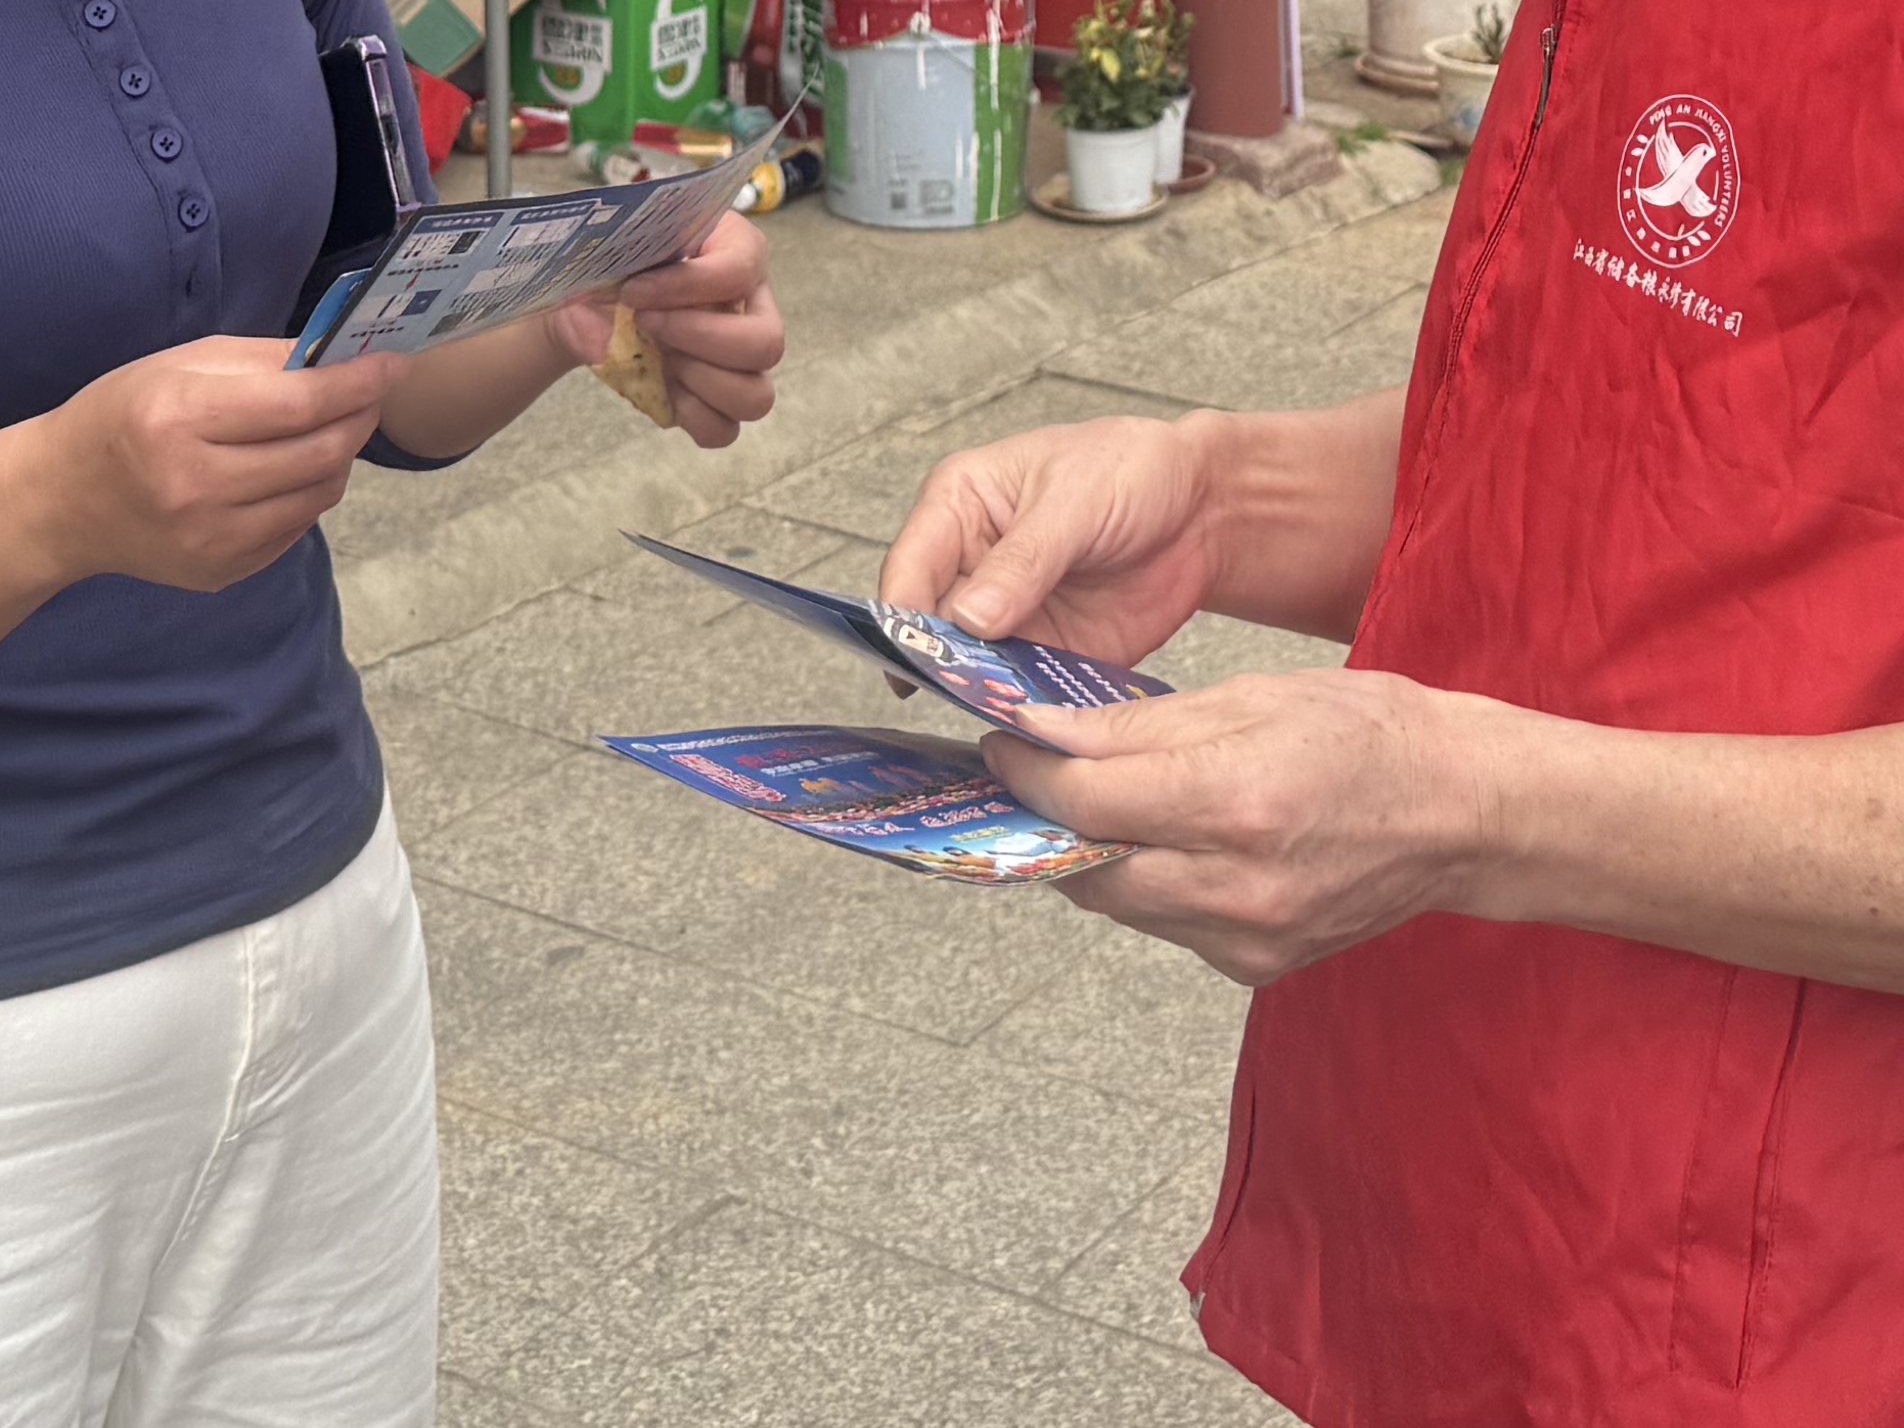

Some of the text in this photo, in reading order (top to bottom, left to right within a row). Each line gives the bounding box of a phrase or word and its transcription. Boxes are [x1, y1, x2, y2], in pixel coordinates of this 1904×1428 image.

[1573, 238, 1744, 337] 江西省储备粮永修有限公司
